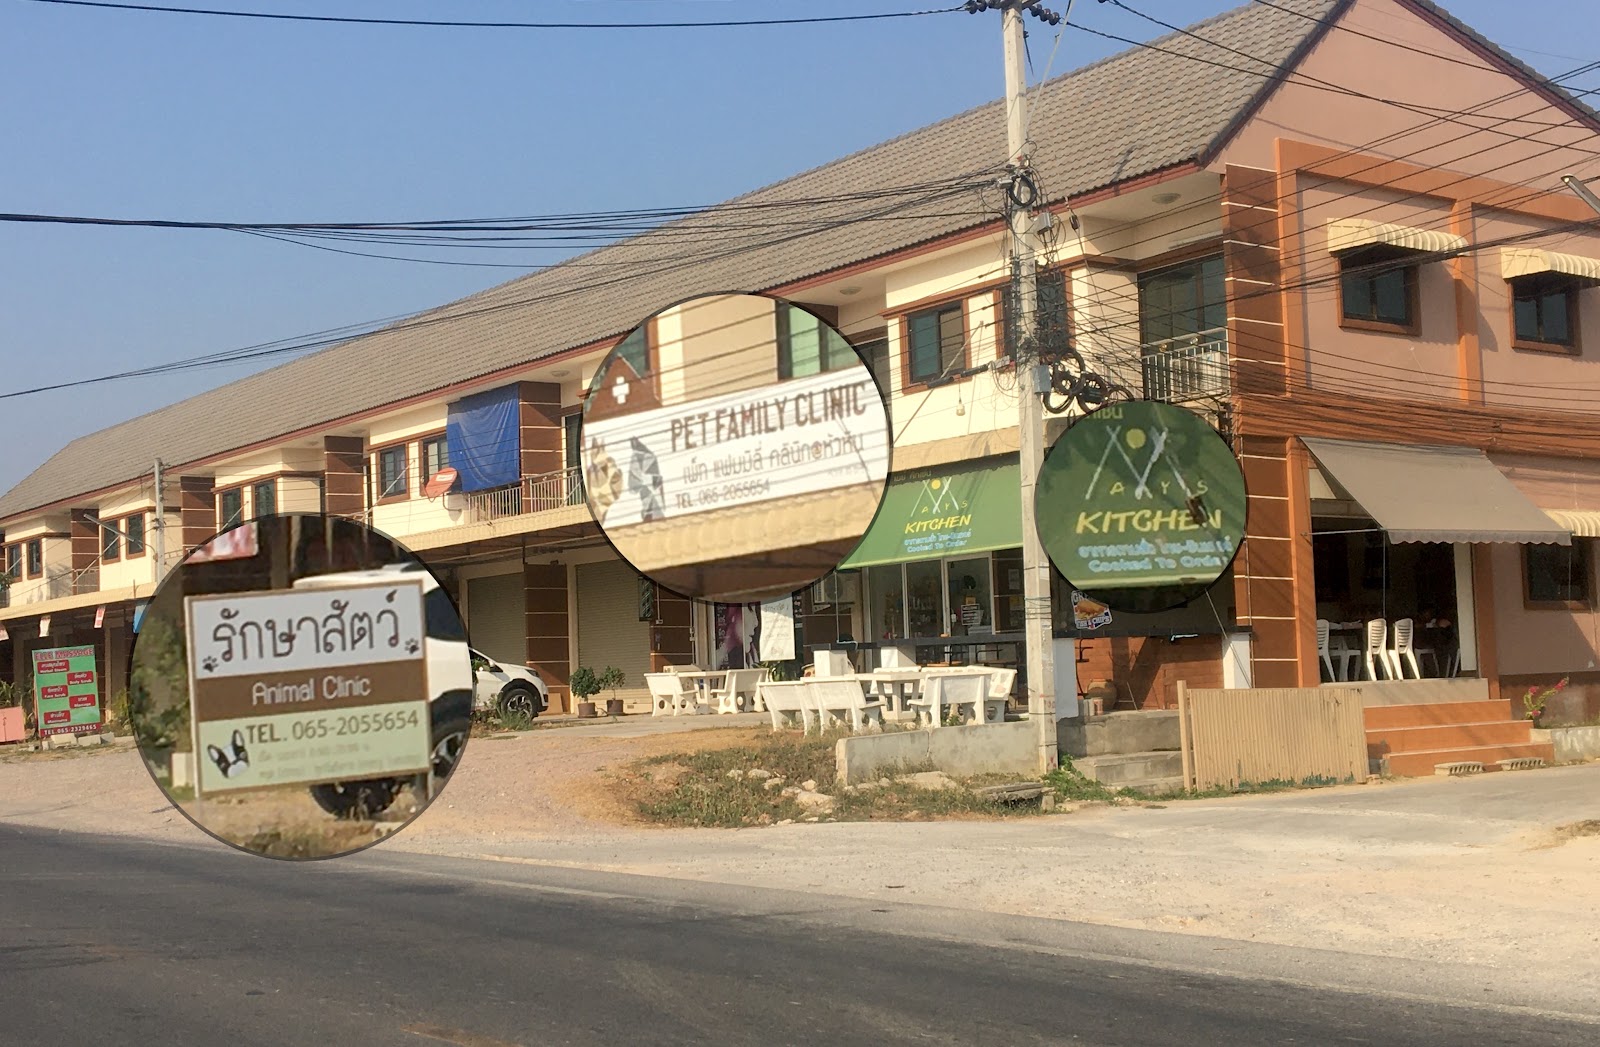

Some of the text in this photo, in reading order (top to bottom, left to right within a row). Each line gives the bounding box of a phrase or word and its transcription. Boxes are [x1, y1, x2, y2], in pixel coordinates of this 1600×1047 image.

[670, 384, 867, 452] PET FAMILY CLINIC
[698, 478, 771, 505] 065-2055654
[904, 514, 971, 534] KITCHEN
[1154, 557, 1177, 569] To
[213, 590, 400, 662] รักษาสัตว์
[252, 676, 371, 706] Animal Clinic
[246, 710, 419, 745] TEL. 065-2055654
